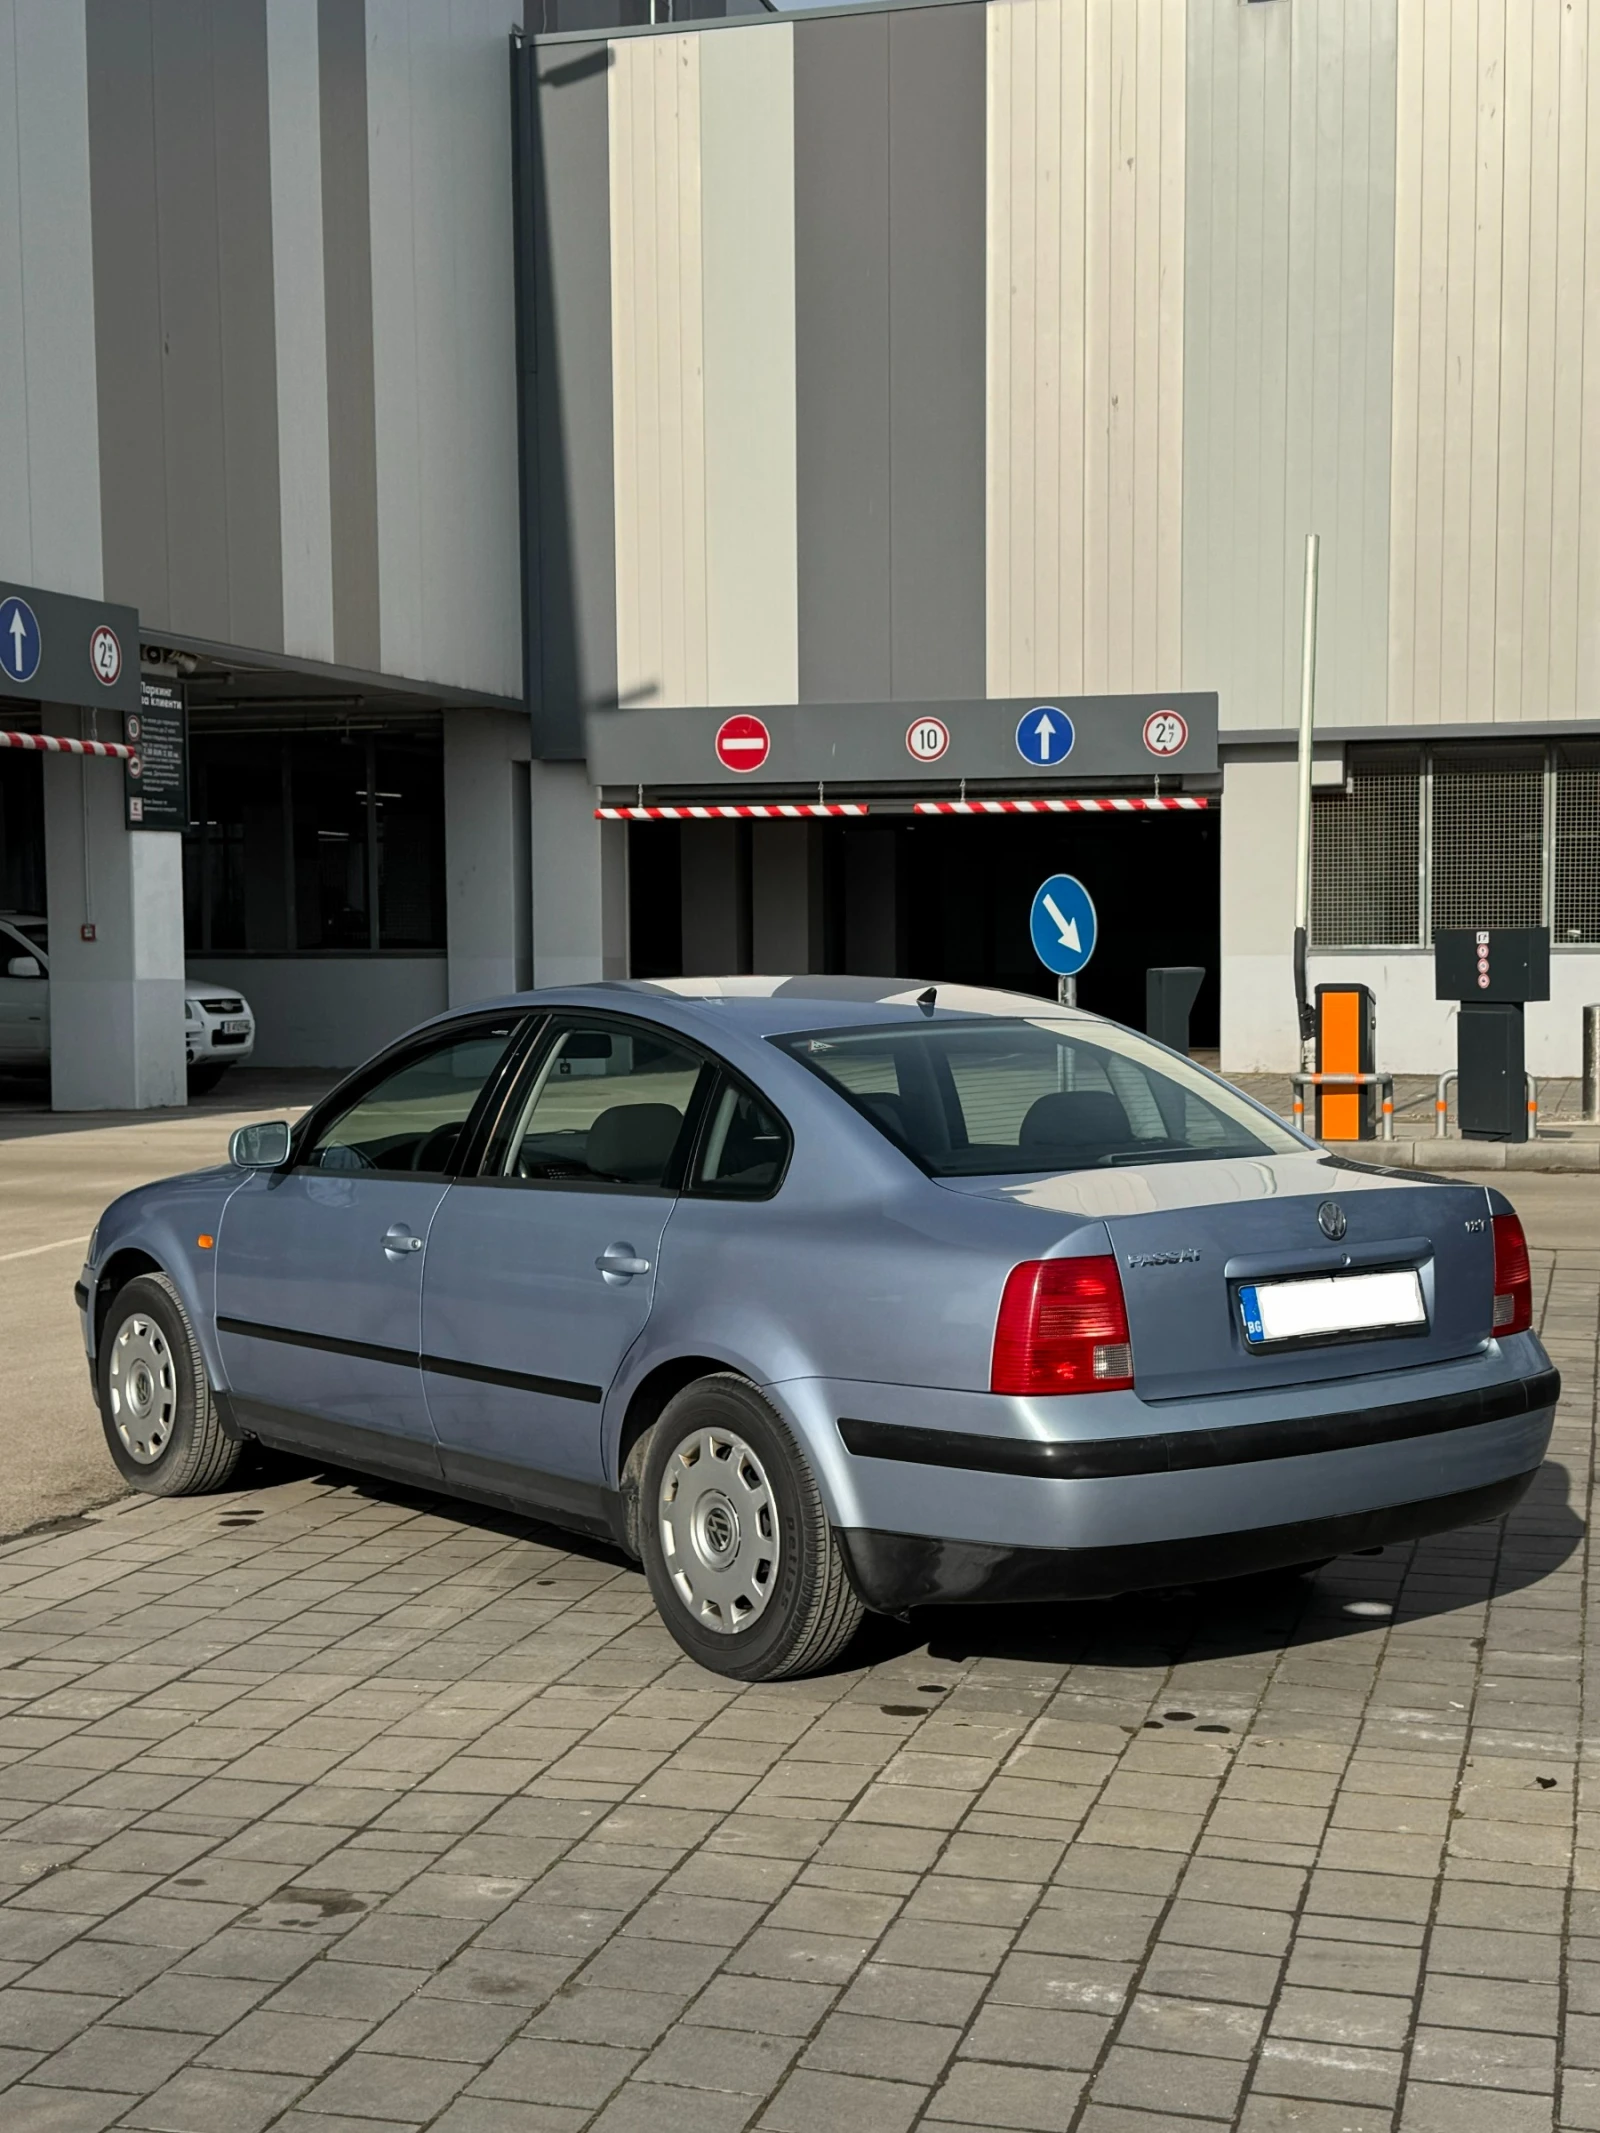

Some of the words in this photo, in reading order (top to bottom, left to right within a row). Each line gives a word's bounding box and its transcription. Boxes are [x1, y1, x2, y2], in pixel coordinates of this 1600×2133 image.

[920, 729, 937, 750] 10
[1127, 1247, 1202, 1268] PASSAT
[1247, 1321, 1262, 1334] BG
